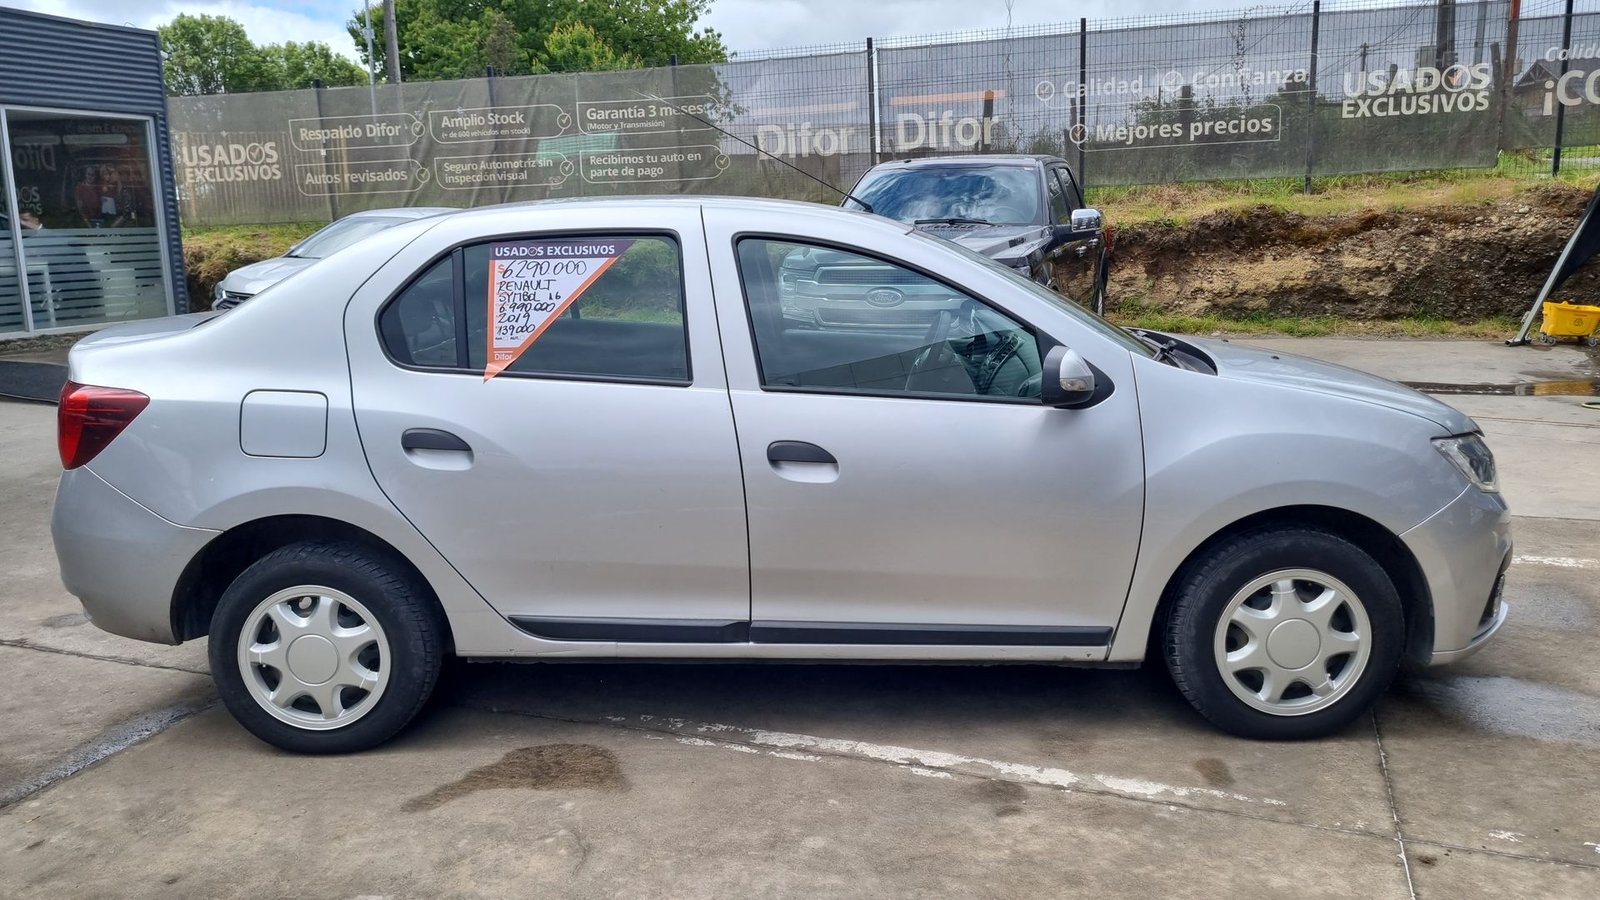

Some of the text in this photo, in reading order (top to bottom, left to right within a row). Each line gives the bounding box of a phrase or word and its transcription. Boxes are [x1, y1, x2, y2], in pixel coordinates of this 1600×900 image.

[1064, 68, 1307, 99] Calidad Confianza
[1343, 63, 1491, 98] USADOS
[586, 103, 704, 120] Garantía 3 meses
[1342, 91, 1490, 119] EXCLUSIVOS
[441, 110, 525, 129] Amplio Stock
[587, 122, 612, 131] (Motor
[620, 119, 665, 129] Transmisión)
[300, 123, 402, 144] Respaldo Difor
[458, 130, 470, 138] 600
[510, 127, 531, 135] stock)
[897, 109, 1001, 151] Difor
[1096, 115, 1272, 145] Mejores precios
[756, 121, 855, 160] Difor
[183, 141, 279, 167] USADOS
[590, 152, 702, 165] Recibimos tu auto en
[186, 164, 282, 184] EXCLUSIVOS
[443, 158, 553, 174] Seguro Automotriz sin
[590, 165, 664, 179] parte de pago
[305, 167, 408, 185] Autos revisados
[445, 170, 528, 185] inspección visual
[495, 245, 615, 257] USADOS EXCLUSIVOS
[498, 279, 557, 293] RENAULT
[498, 291, 541, 303] SYMBOL
[498, 312, 531, 326] 2019
[494, 353, 513, 361] Difor
